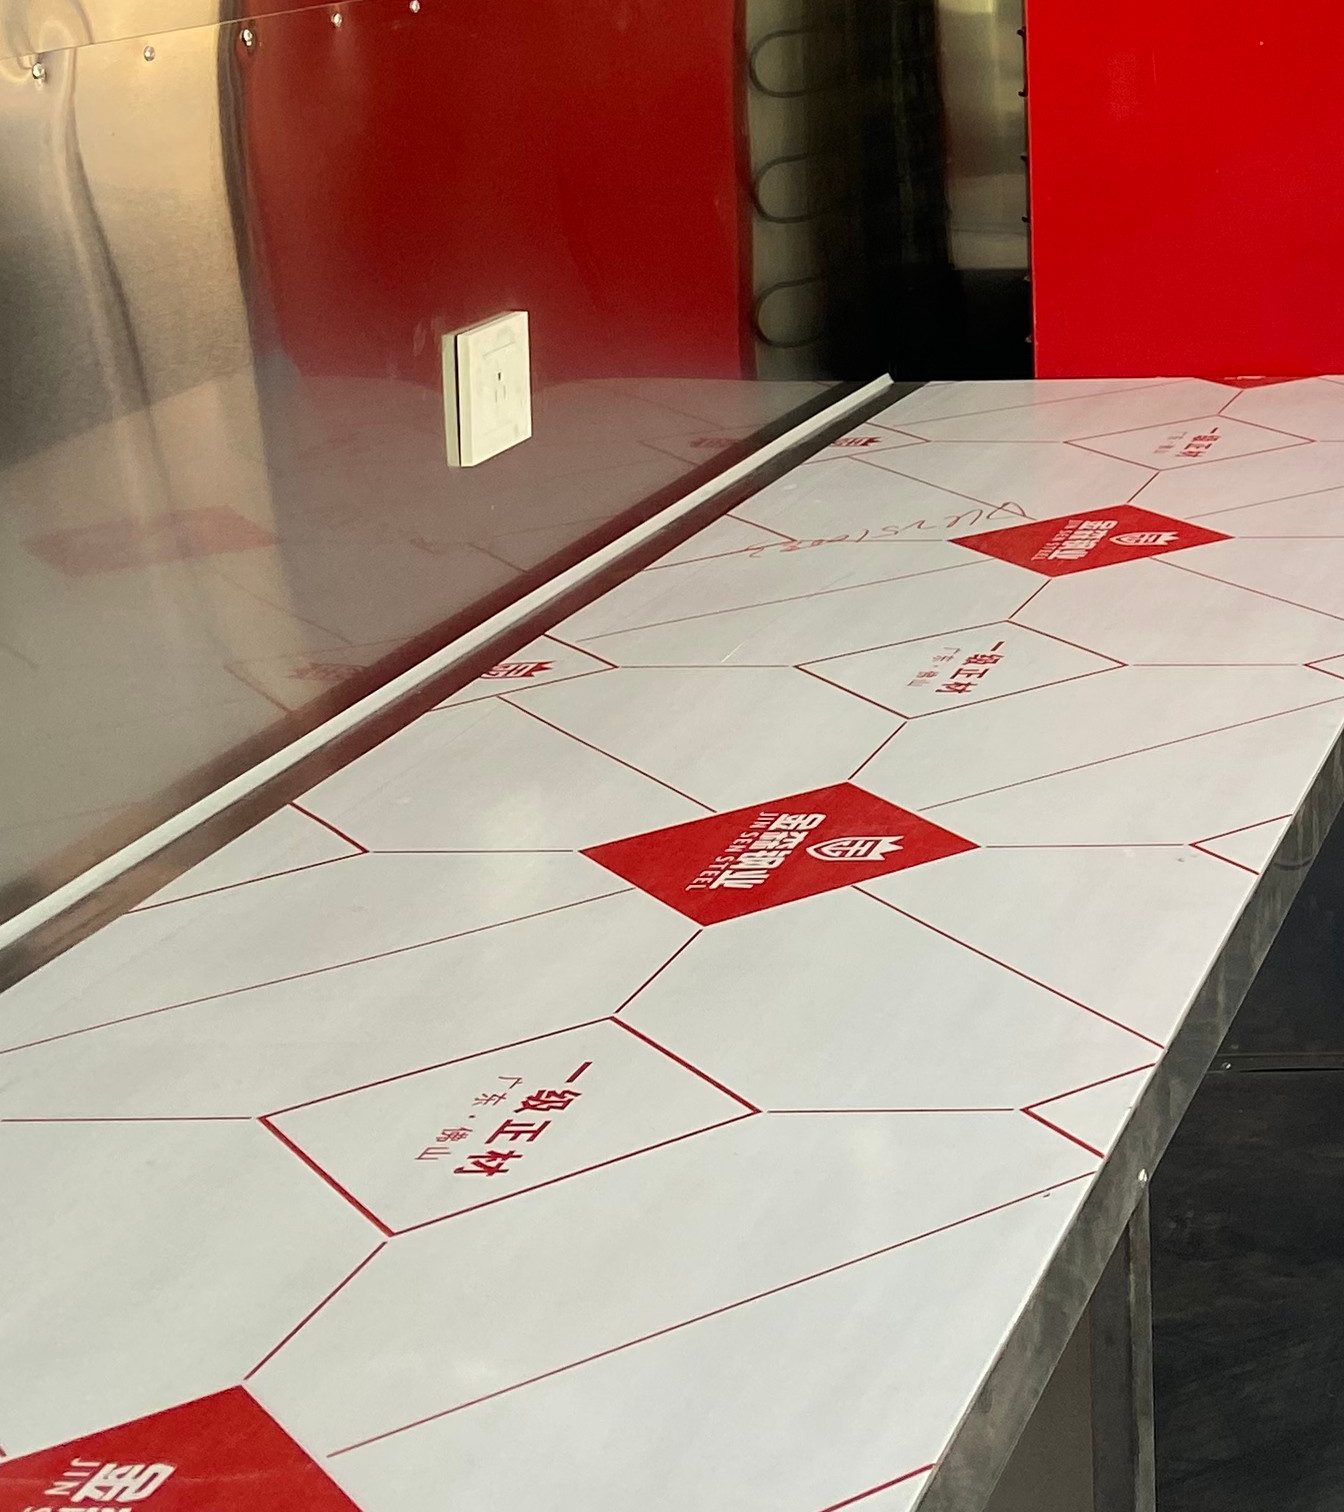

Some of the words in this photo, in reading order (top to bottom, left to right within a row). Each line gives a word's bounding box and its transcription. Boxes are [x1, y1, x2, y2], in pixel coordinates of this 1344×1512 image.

[935, 641, 1004, 693] 一级正材
[750, 811, 779, 828] JIN
[725, 831, 759, 852] SEN
[685, 856, 734, 891] STEEL
[454, 1061, 592, 1175] 一级正材
[44, 1457, 101, 1495] JIN
[58, 1463, 177, 1512] 金
